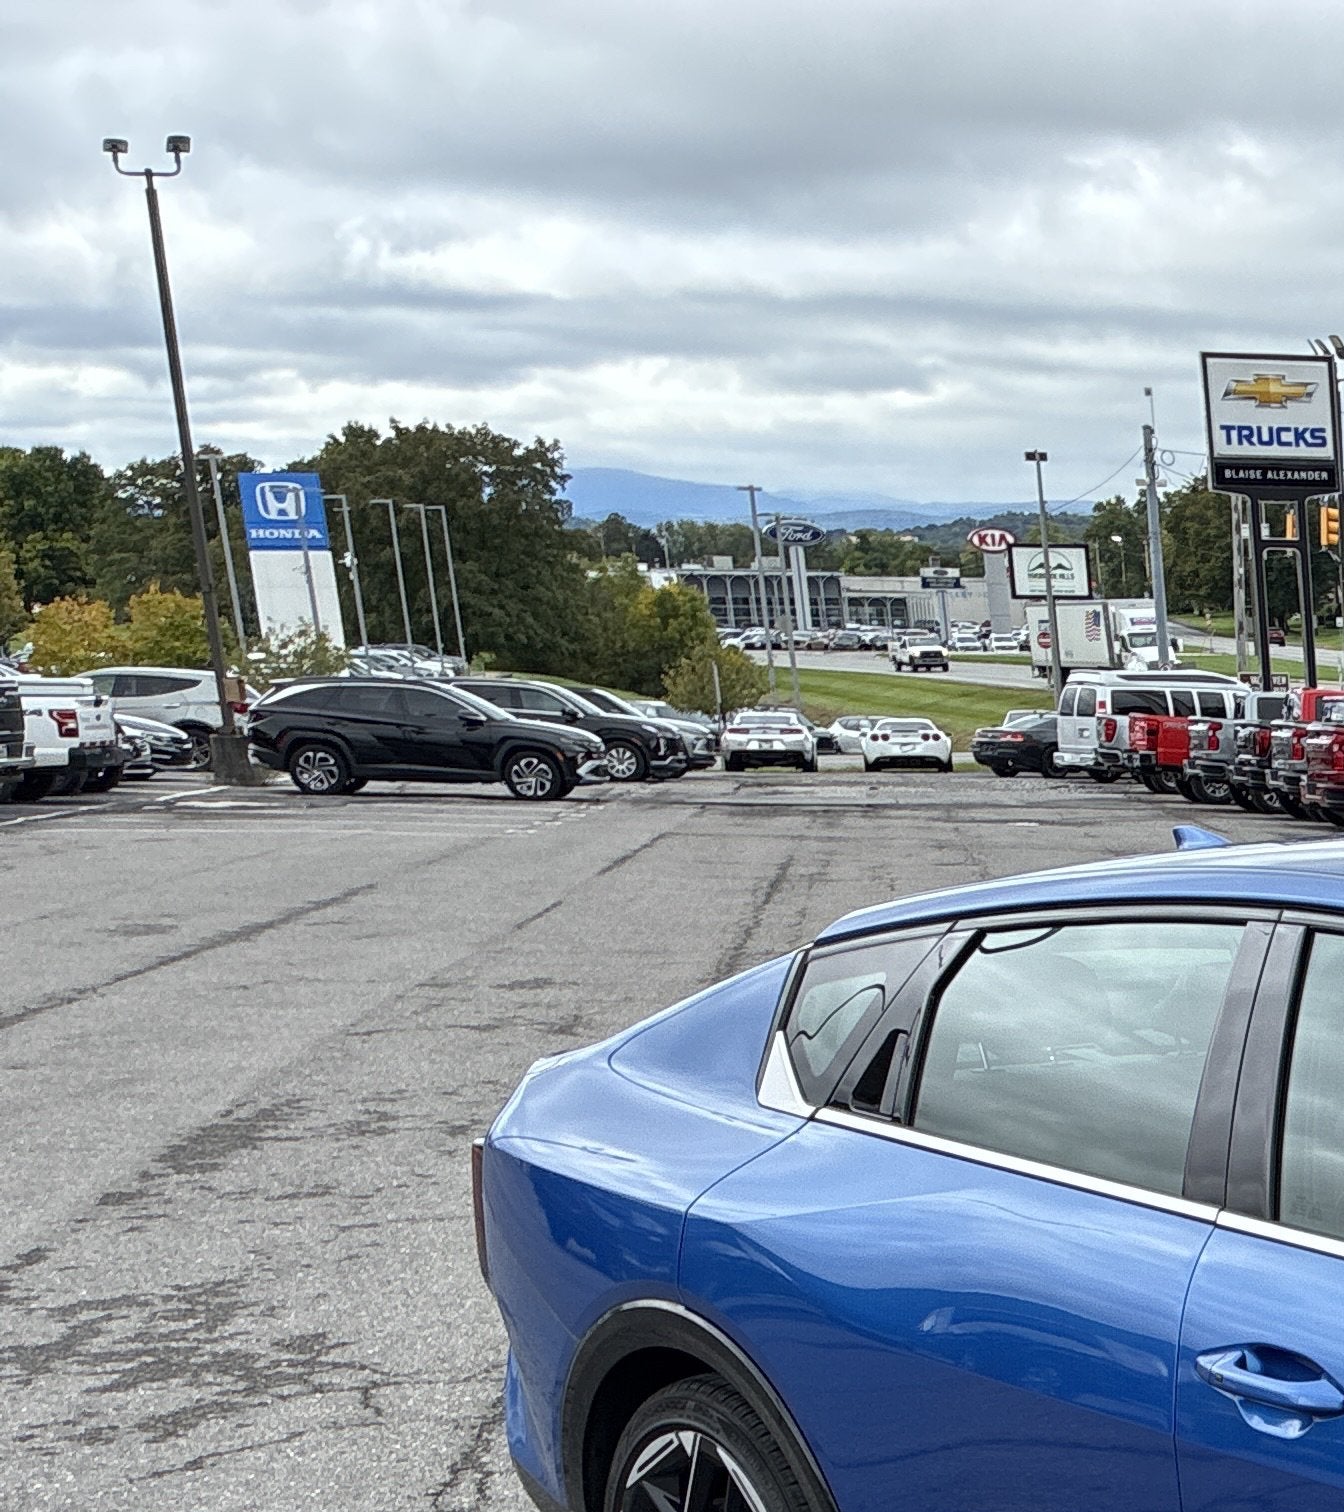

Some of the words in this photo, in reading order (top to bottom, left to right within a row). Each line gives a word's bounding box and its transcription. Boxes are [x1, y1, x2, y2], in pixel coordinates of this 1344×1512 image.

[1219, 424, 1328, 448] TRUCKS
[1224, 468, 1263, 479] BLAISE
[1266, 470, 1329, 481] ALEXANDER
[249, 528, 324, 539] HONDA
[977, 533, 1010, 547] KIA
